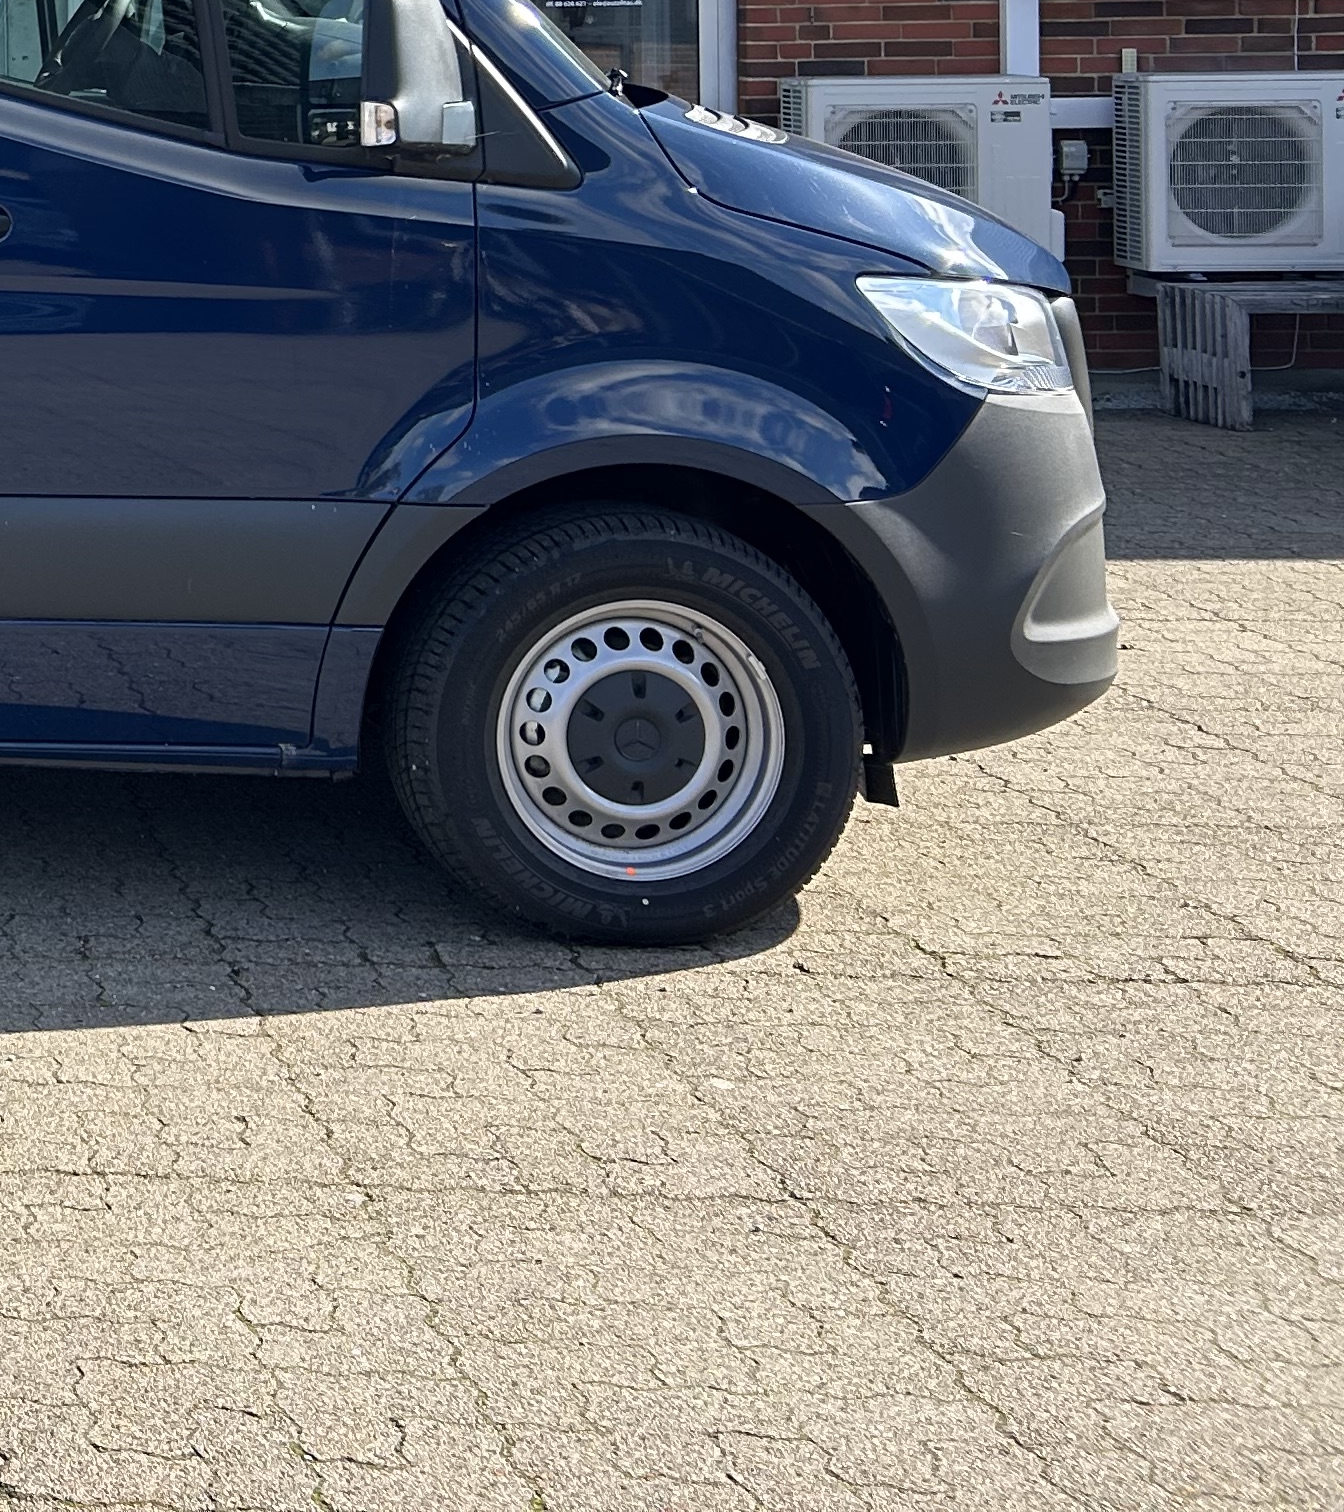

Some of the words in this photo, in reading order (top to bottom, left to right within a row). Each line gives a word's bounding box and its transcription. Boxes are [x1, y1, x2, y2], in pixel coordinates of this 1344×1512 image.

[701, 566, 821, 670] MICHELIN
[470, 817, 593, 919] MICHELIN
[767, 801, 826, 881] LATITUDE
[702, 903, 715, 919] 3
[720, 875, 768, 912] Sport
